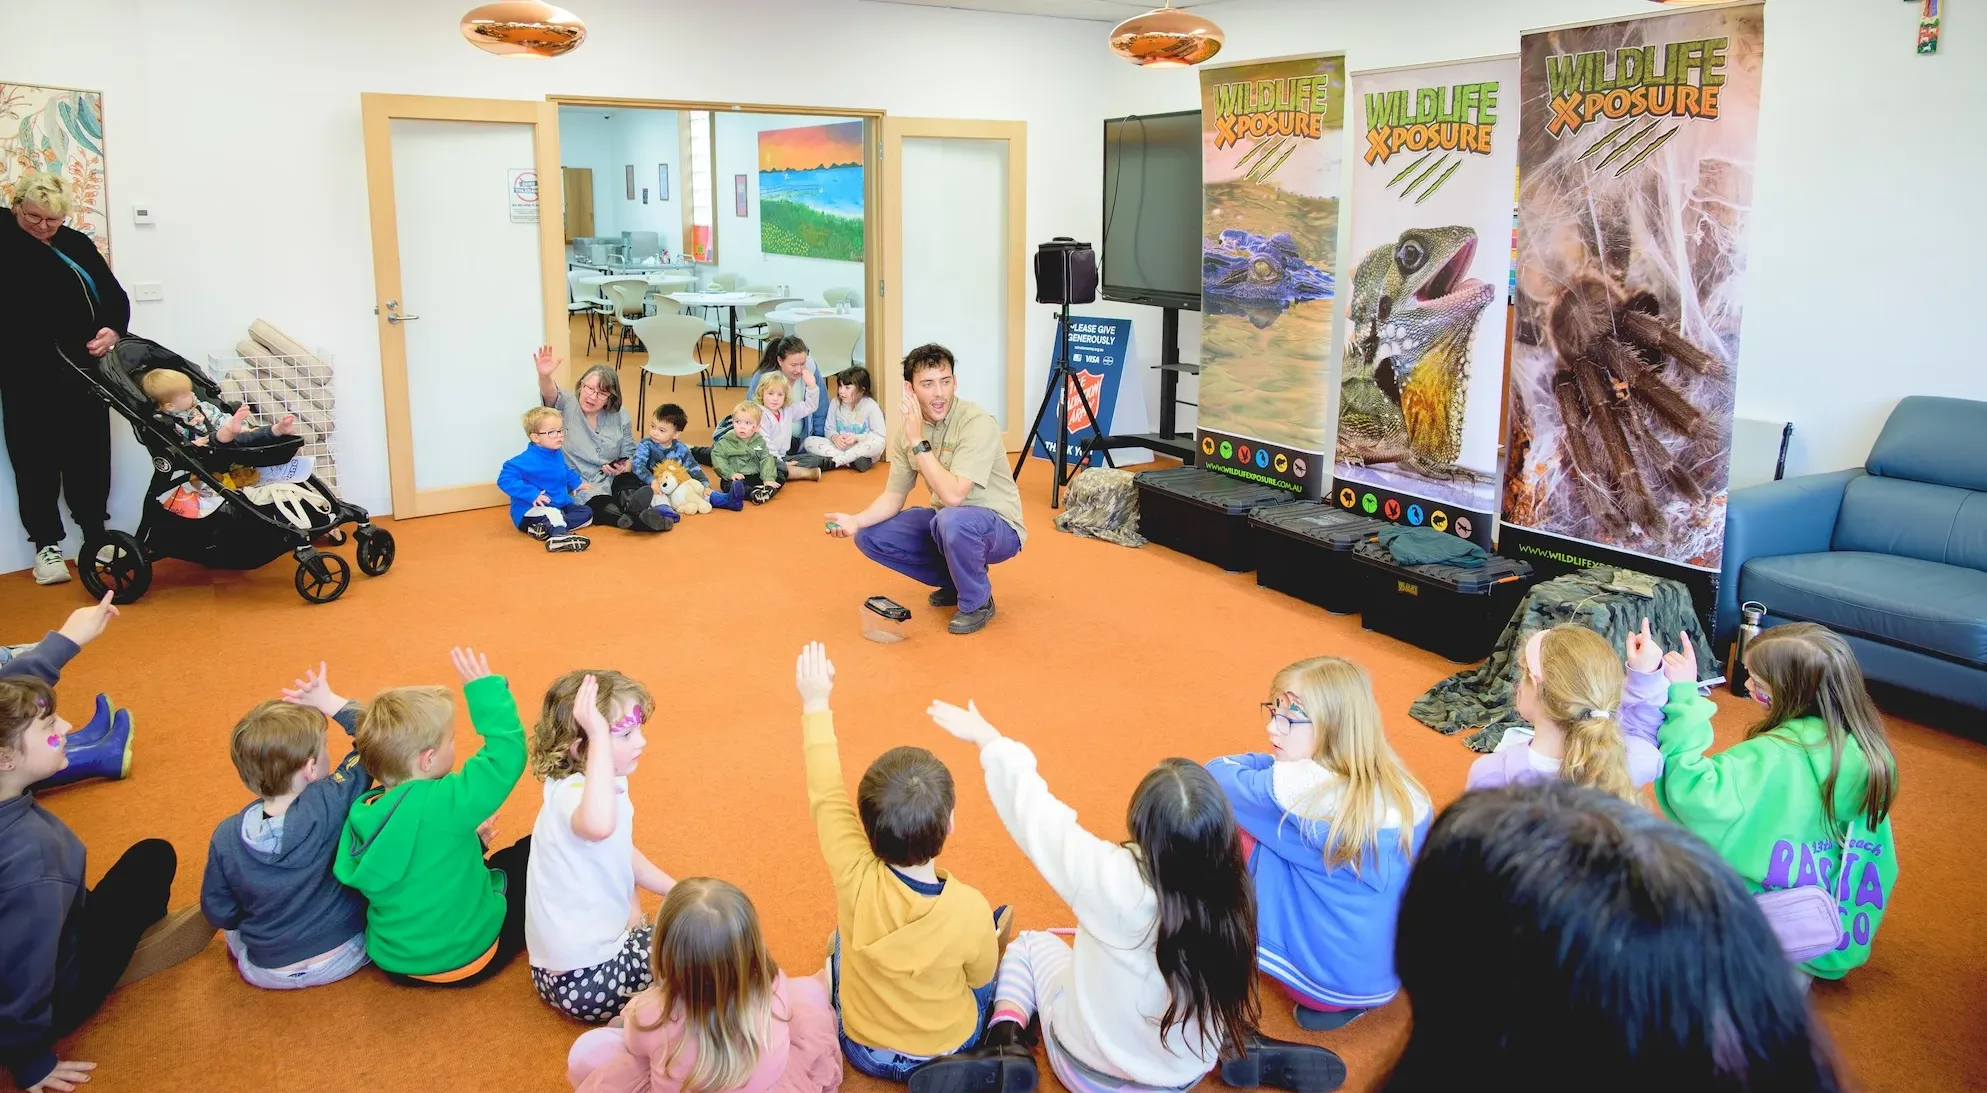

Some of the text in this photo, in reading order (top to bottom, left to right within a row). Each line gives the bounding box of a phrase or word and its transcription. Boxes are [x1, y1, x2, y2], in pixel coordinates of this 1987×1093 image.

[1547, 37, 1729, 98] WILDLIFE
[1213, 75, 1327, 116] WILDLIFE
[1365, 81, 1499, 132] WILDLIFE
[1546, 85, 1720, 140] XPOSURE
[1214, 111, 1323, 150] XPOSURE
[1364, 123, 1493, 166] XPOSURE
[1068, 333, 1116, 345] GENEROUSLY
[1098, 325, 1116, 335] GIVE
[1086, 355, 1100, 364] VISA
[1045, 441, 1074, 456] THK
[1205, 462, 1303, 493] WWW.WILDLIFEXPOSURE.COM.AU
[1848, 839, 1883, 857] each
